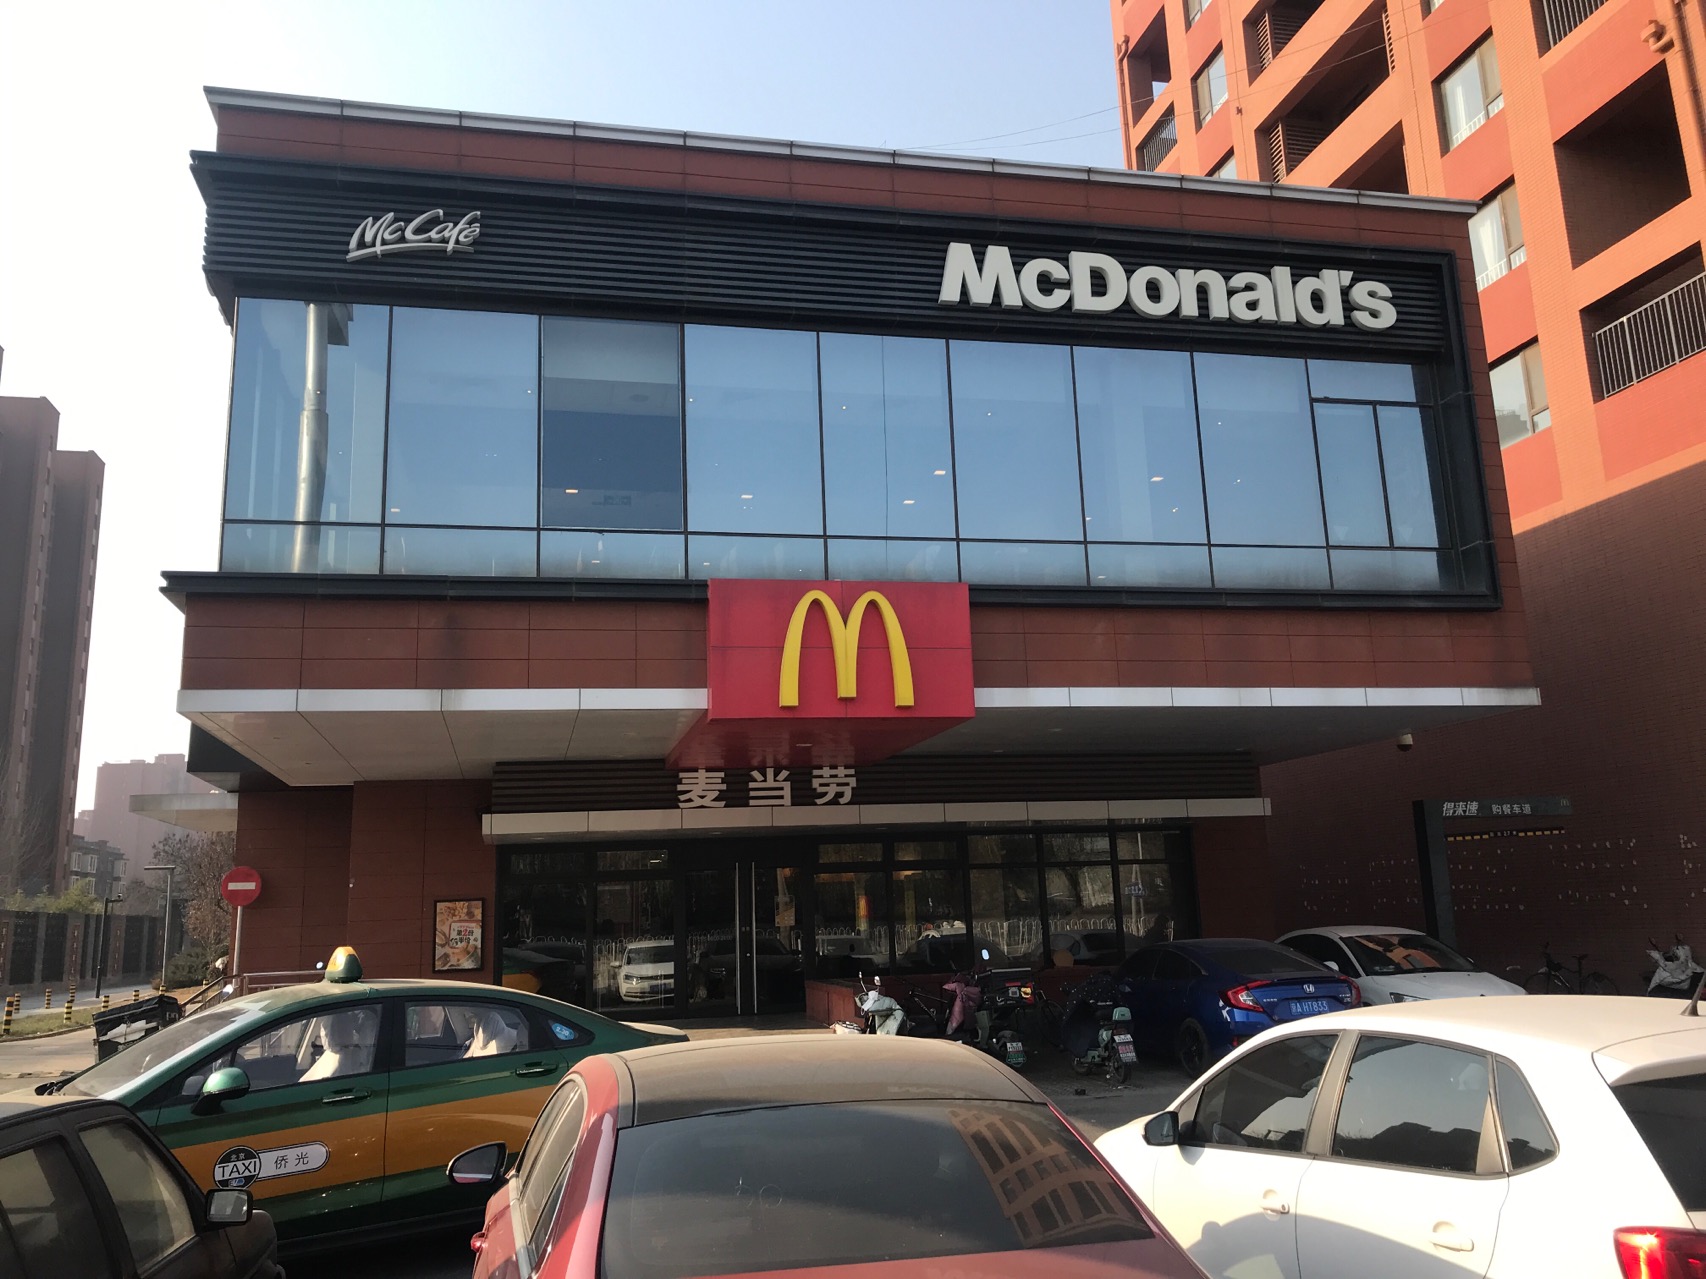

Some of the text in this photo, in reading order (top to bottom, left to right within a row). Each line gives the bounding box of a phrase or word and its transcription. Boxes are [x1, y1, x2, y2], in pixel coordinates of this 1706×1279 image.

[347, 209, 481, 261] McCafé
[938, 241, 1398, 331] McDonald's
[676, 766, 857, 808] 麦当劳
[1442, 801, 1532, 816] 得来速 购餐车道
[218, 1161, 257, 1178] TAXI
[273, 1151, 310, 1170] 侨光
